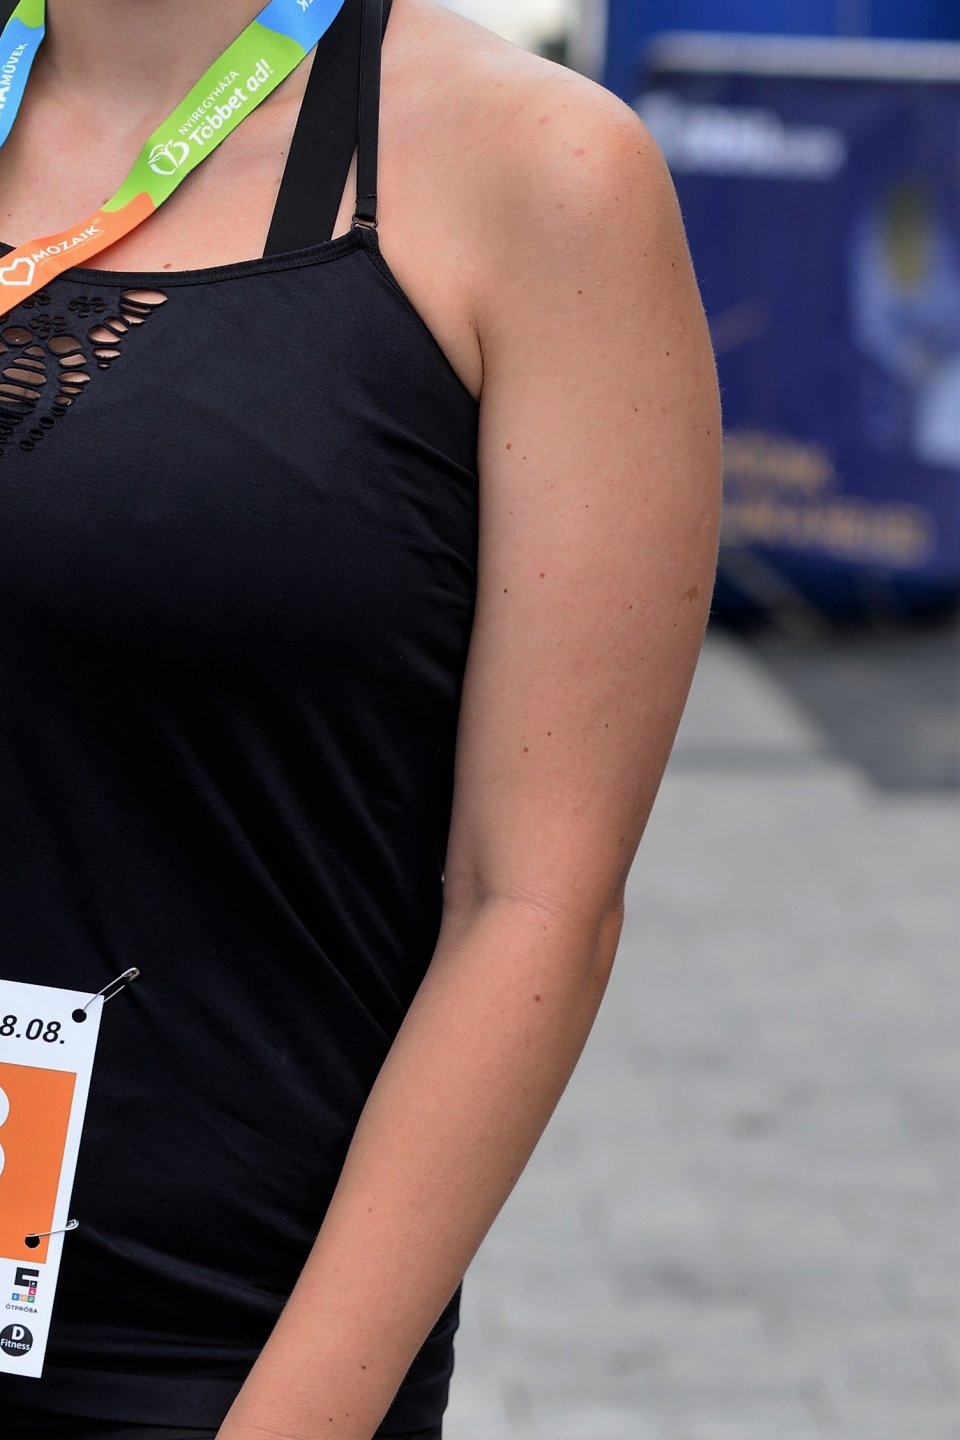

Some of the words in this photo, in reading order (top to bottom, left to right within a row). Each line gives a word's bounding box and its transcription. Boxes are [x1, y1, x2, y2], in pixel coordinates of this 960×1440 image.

[178, 70, 240, 135] NYÍREGYHÁZA
[188, 87, 248, 147] Többet
[31, 225, 100, 263] MOZAIK
[0, 1338, 31, 1351] Fitness
[11, 1325, 25, 1341] D
